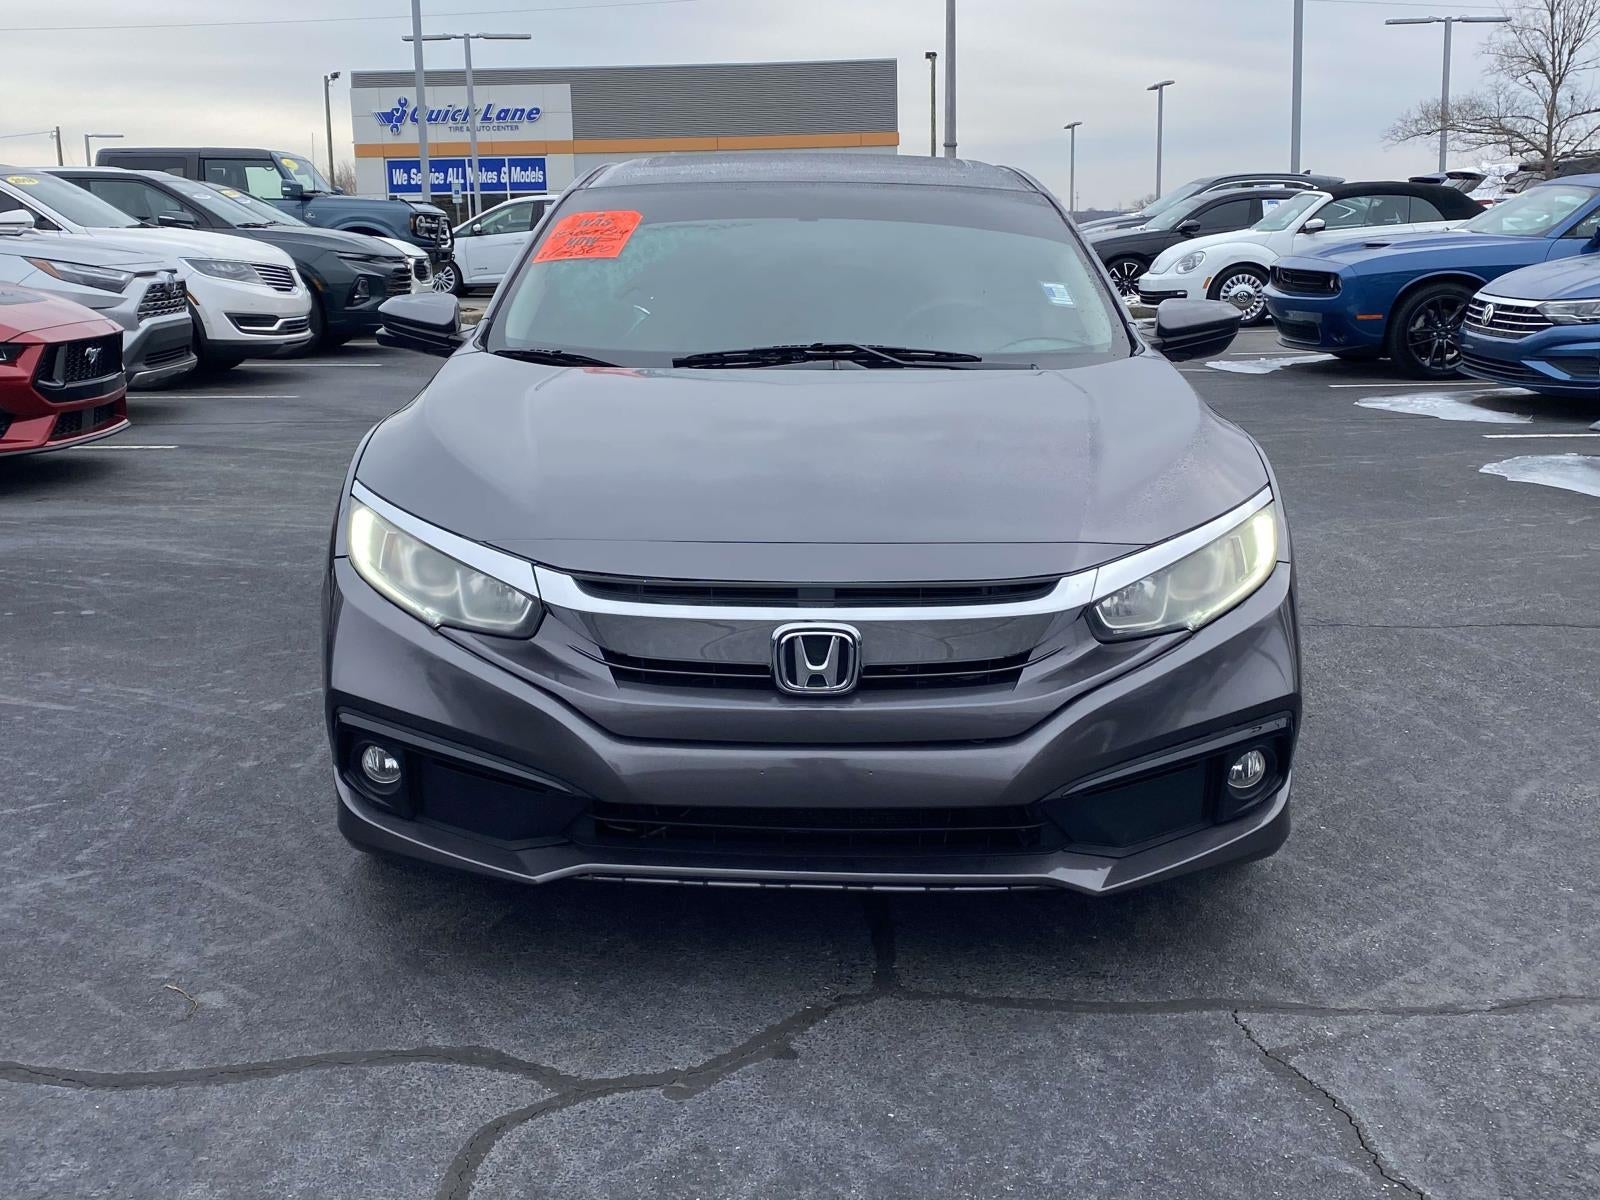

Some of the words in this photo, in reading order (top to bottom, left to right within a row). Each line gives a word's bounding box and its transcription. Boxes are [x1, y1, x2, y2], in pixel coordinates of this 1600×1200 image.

[480, 103, 541, 123] Lane
[491, 124, 519, 132] CENTER
[392, 168, 408, 185] We
[410, 168, 444, 184] Sevice
[446, 167, 465, 184] ALL
[500, 167, 508, 183] &
[511, 166, 544, 183] Models
